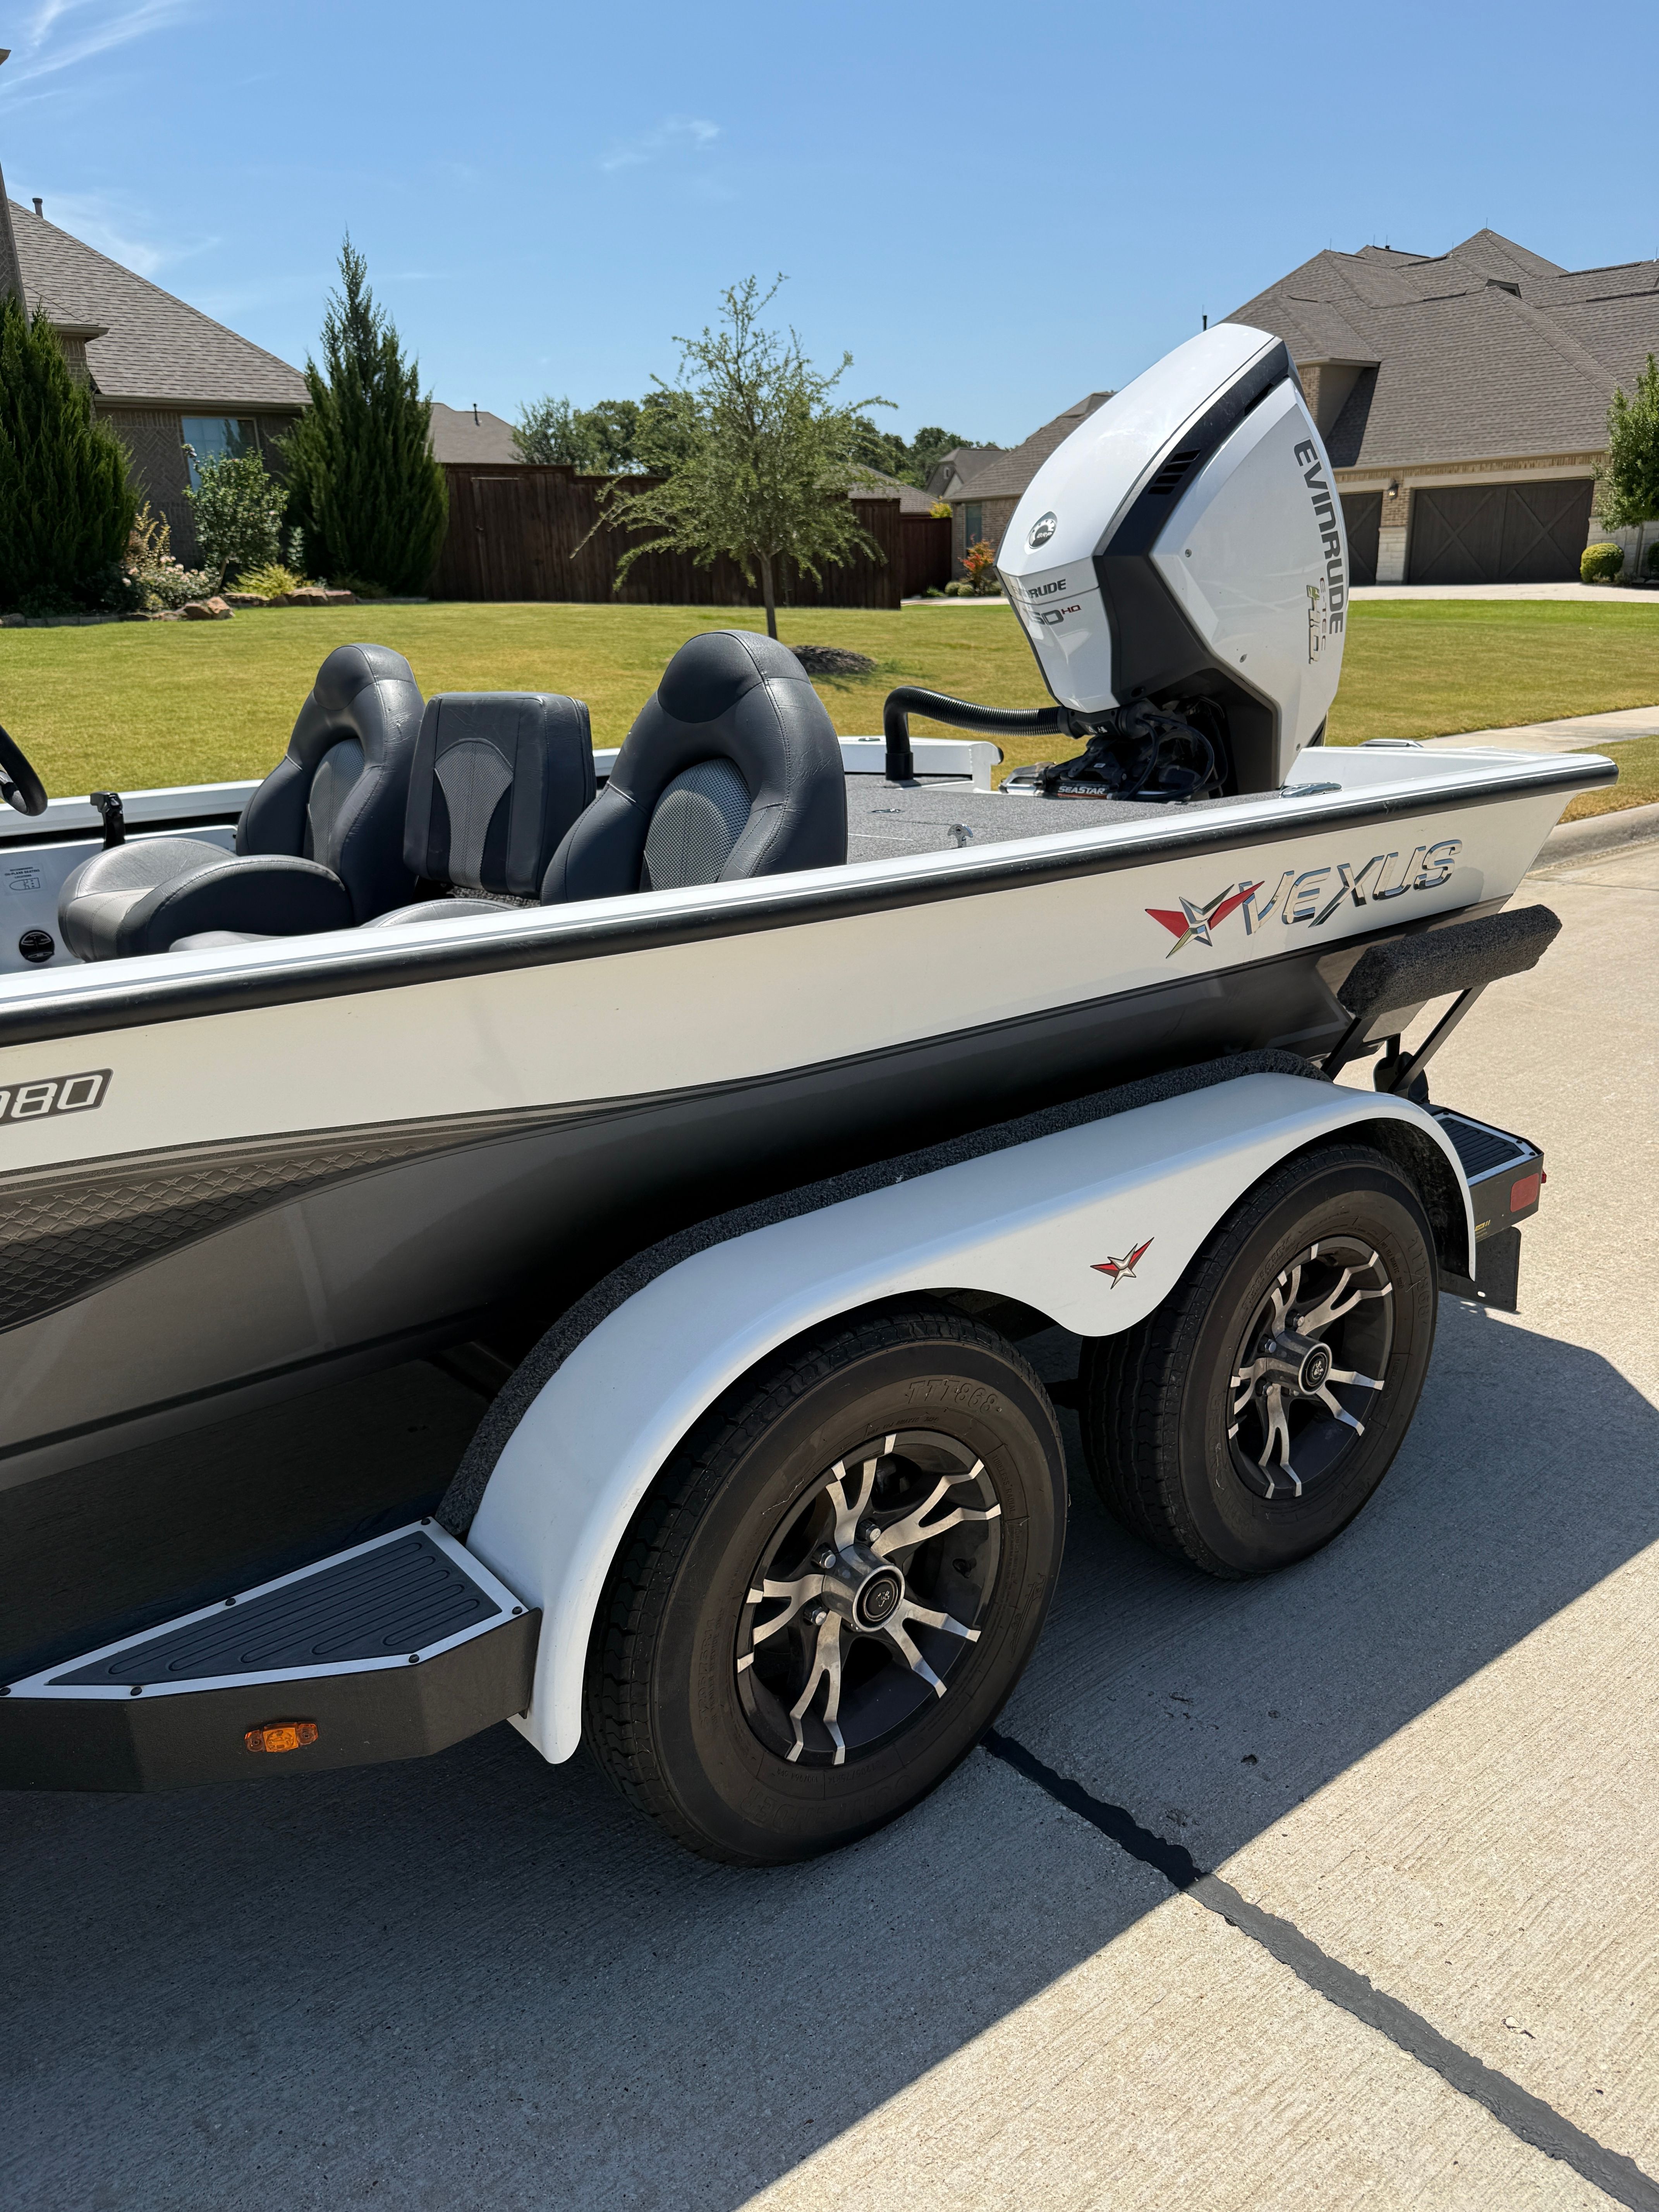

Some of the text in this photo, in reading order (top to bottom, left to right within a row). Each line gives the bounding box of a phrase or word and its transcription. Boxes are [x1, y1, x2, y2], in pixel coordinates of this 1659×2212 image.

[1294, 439, 1343, 634] EVINRUDE
[1058, 786, 1106, 794] SEASTAR
[1239, 839, 1463, 936] VEXUS
[907, 1379, 998, 1414] TTT868
[991, 1455, 1009, 1487] TUBELESS
[1005, 1486, 1017, 1514] RADIAL
